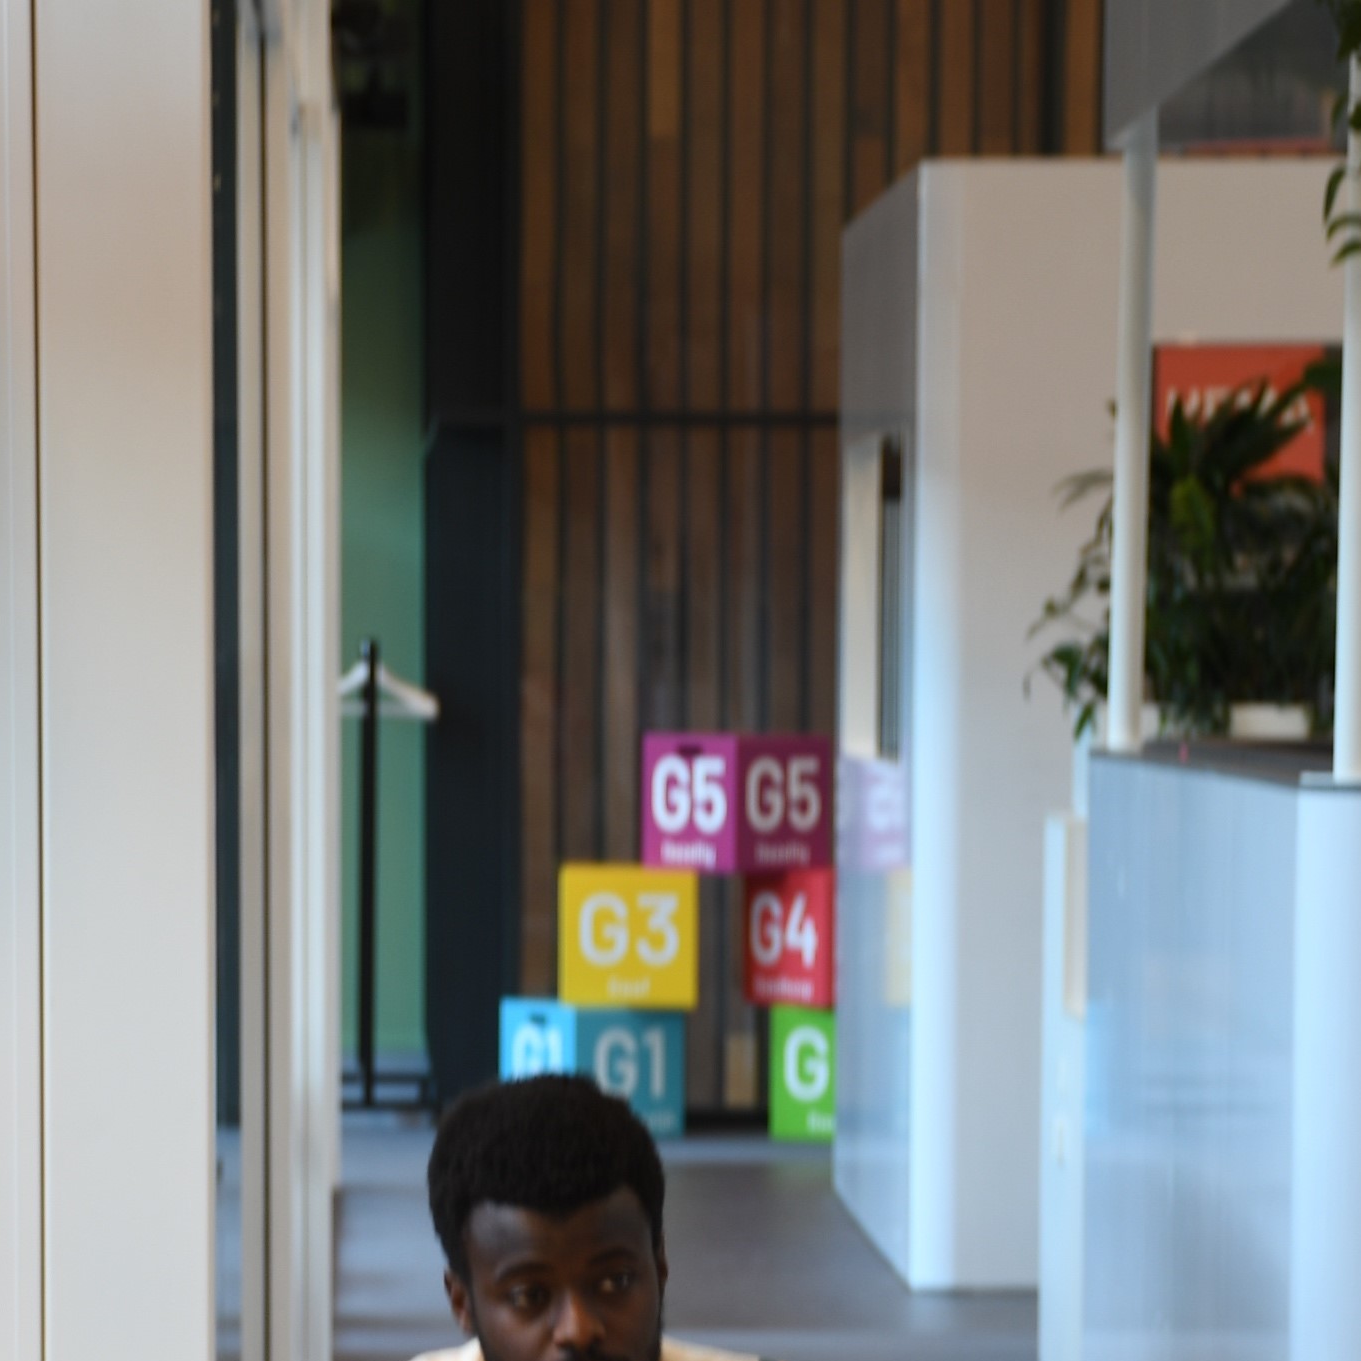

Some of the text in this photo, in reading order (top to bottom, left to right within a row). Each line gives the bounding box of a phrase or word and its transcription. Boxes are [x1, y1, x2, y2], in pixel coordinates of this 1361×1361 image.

[651, 754, 727, 835] G5
[745, 756, 821, 834] G5
[578, 891, 680, 967] G3
[750, 891, 817, 967] G4
[594, 1026, 666, 1100] G1
